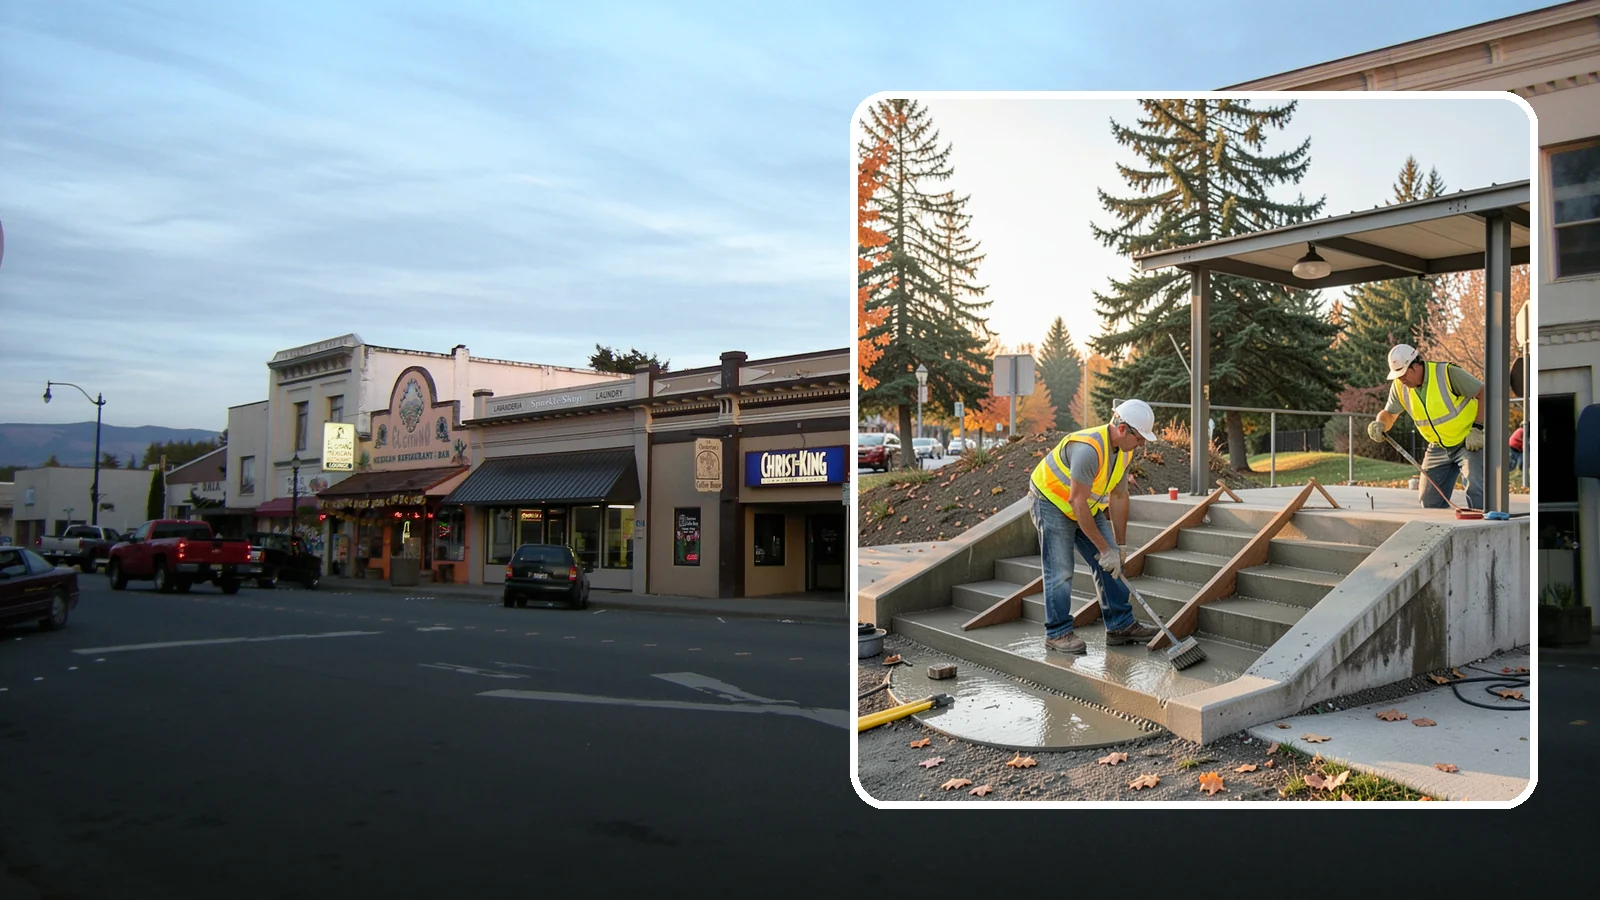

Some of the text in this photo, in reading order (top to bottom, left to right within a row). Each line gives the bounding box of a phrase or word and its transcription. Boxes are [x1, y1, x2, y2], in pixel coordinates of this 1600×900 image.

[494, 389, 624, 413] LAVANDERIA Sparkle Shop LAUNDRY
[391, 425, 401, 449] EL
[373, 454, 396, 464] MEXICAN
[397, 451, 433, 462] RESTAURANT
[438, 450, 450, 459] BAR
[696, 480, 721, 489] Coffee House
